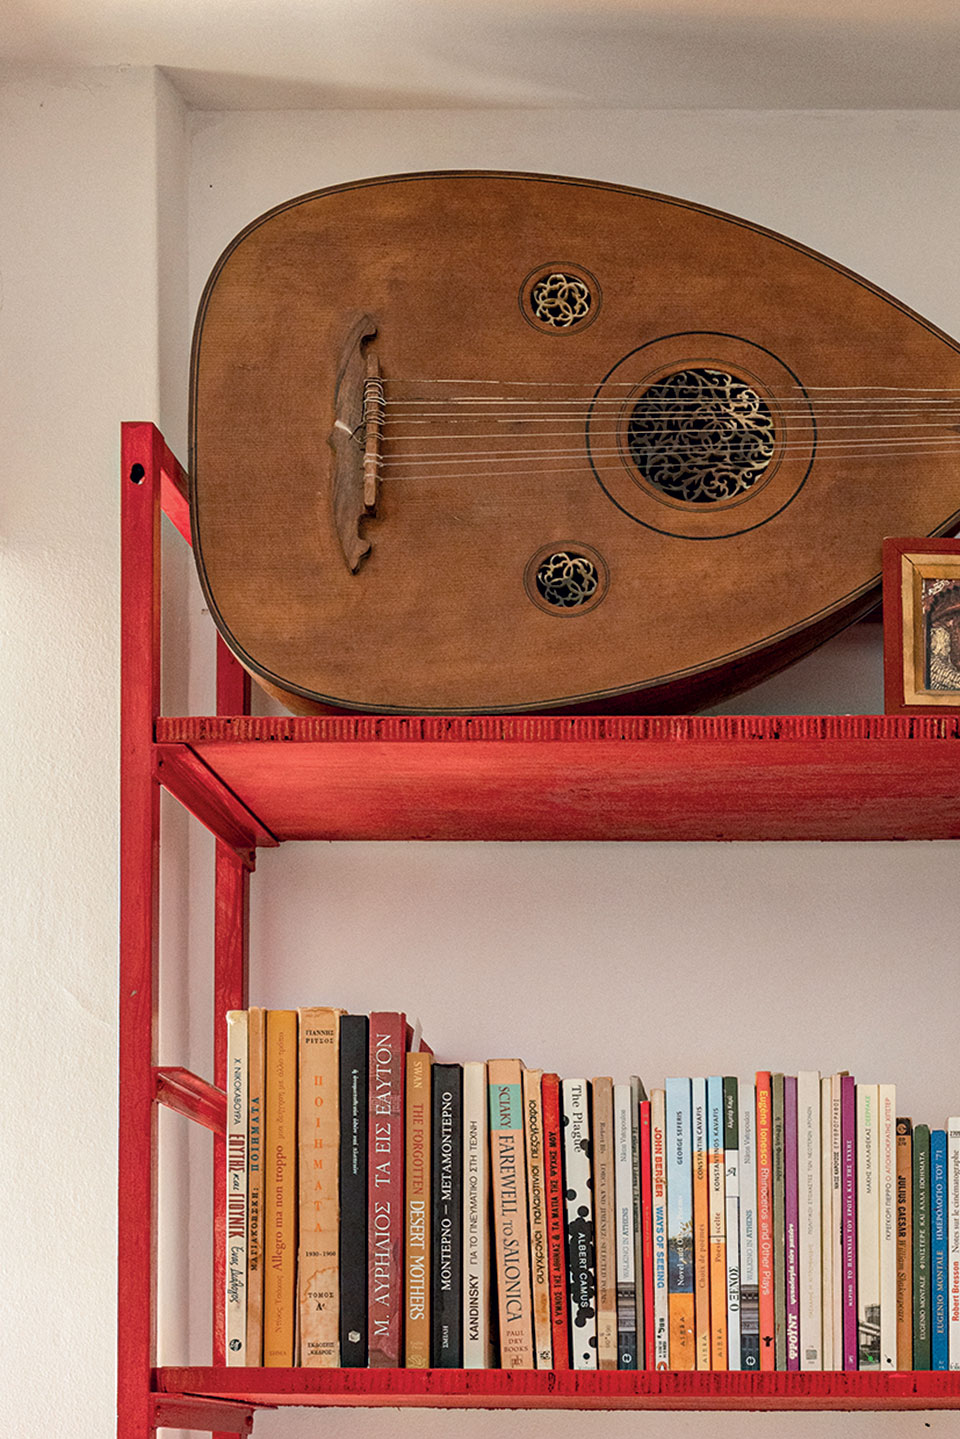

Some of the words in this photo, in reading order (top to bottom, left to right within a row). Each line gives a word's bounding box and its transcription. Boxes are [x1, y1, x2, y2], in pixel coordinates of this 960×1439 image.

[376, 1034, 392, 1115] ΕΑΥΤΟΝ
[413, 1061, 423, 1089] SWAN
[498, 1085, 512, 1128] SCIAKY
[572, 1085, 583, 1108] The
[759, 1090, 770, 1127] Eugène
[412, 1103, 422, 1126] THE
[695, 1106, 703, 1136] CAVAFIS
[711, 1108, 719, 1136] KAVAFIS
[376, 1123, 391, 1153] ΕΙΣ
[571, 1111, 585, 1153] Plague
[654, 1127, 663, 1154] JOHN
[760, 1128, 769, 1165] Ionesco
[274, 1146, 285, 1182] troppo
[375, 1161, 391, 1188] ΤΑ
[412, 1128, 423, 1195] FORGOTTEN
[696, 1137, 704, 1181] CONSTANTIN
[712, 1138, 720, 1192] KONSTANTINOS
[498, 1135, 516, 1217] FAREWELL
[655, 1156, 664, 1197] BERGER
[897, 1175, 907, 1204] JULIUS
[275, 1187, 283, 1208] non
[760, 1168, 771, 1220] Rhinoceros
[275, 1212, 283, 1229] ma
[409, 1199, 425, 1249] DESERT
[502, 1220, 514, 1236] TO
[655, 1206, 664, 1234] WAYS
[761, 1222, 771, 1236] and
[898, 1206, 907, 1237] CAESAR
[272, 1232, 285, 1272] Allegro
[375, 1201, 390, 1307] ΑΥΡΗΛΙΟΣ
[578, 1233, 589, 1270] ALBERT
[656, 1236, 664, 1249] OF
[761, 1240, 771, 1268] Other
[502, 1240, 522, 1323] SALONICA
[656, 1251, 665, 1289] SEEING
[761, 1270, 773, 1296] Plays
[951, 1261, 960, 1294] Bresson
[409, 1255, 425, 1321] MOTHERS
[579, 1273, 590, 1307] CAMUS
[469, 1275, 479, 1341] KANDINSKY
[951, 1296, 960, 1322] Robert
[375, 1314, 390, 1337] Μ.
